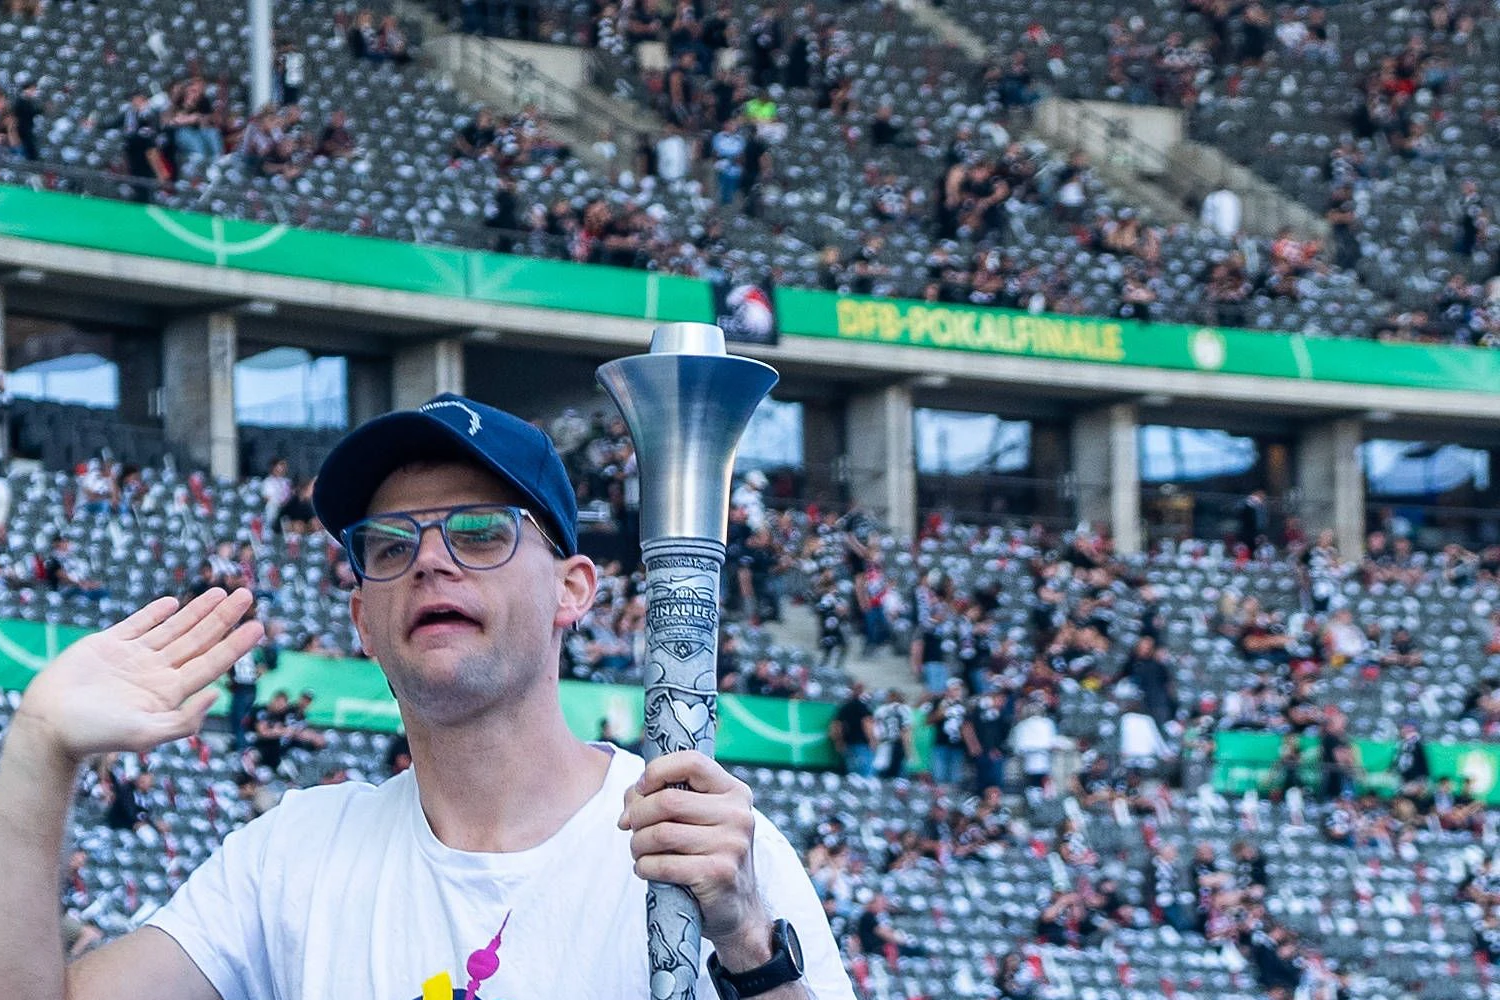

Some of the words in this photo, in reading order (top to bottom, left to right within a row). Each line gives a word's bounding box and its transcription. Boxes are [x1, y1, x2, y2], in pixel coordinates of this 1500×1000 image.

[836, 299, 1125, 362] DFB-POKALFINALE
[651, 603, 690, 618] FINAL
[693, 604, 718, 622] LEG
